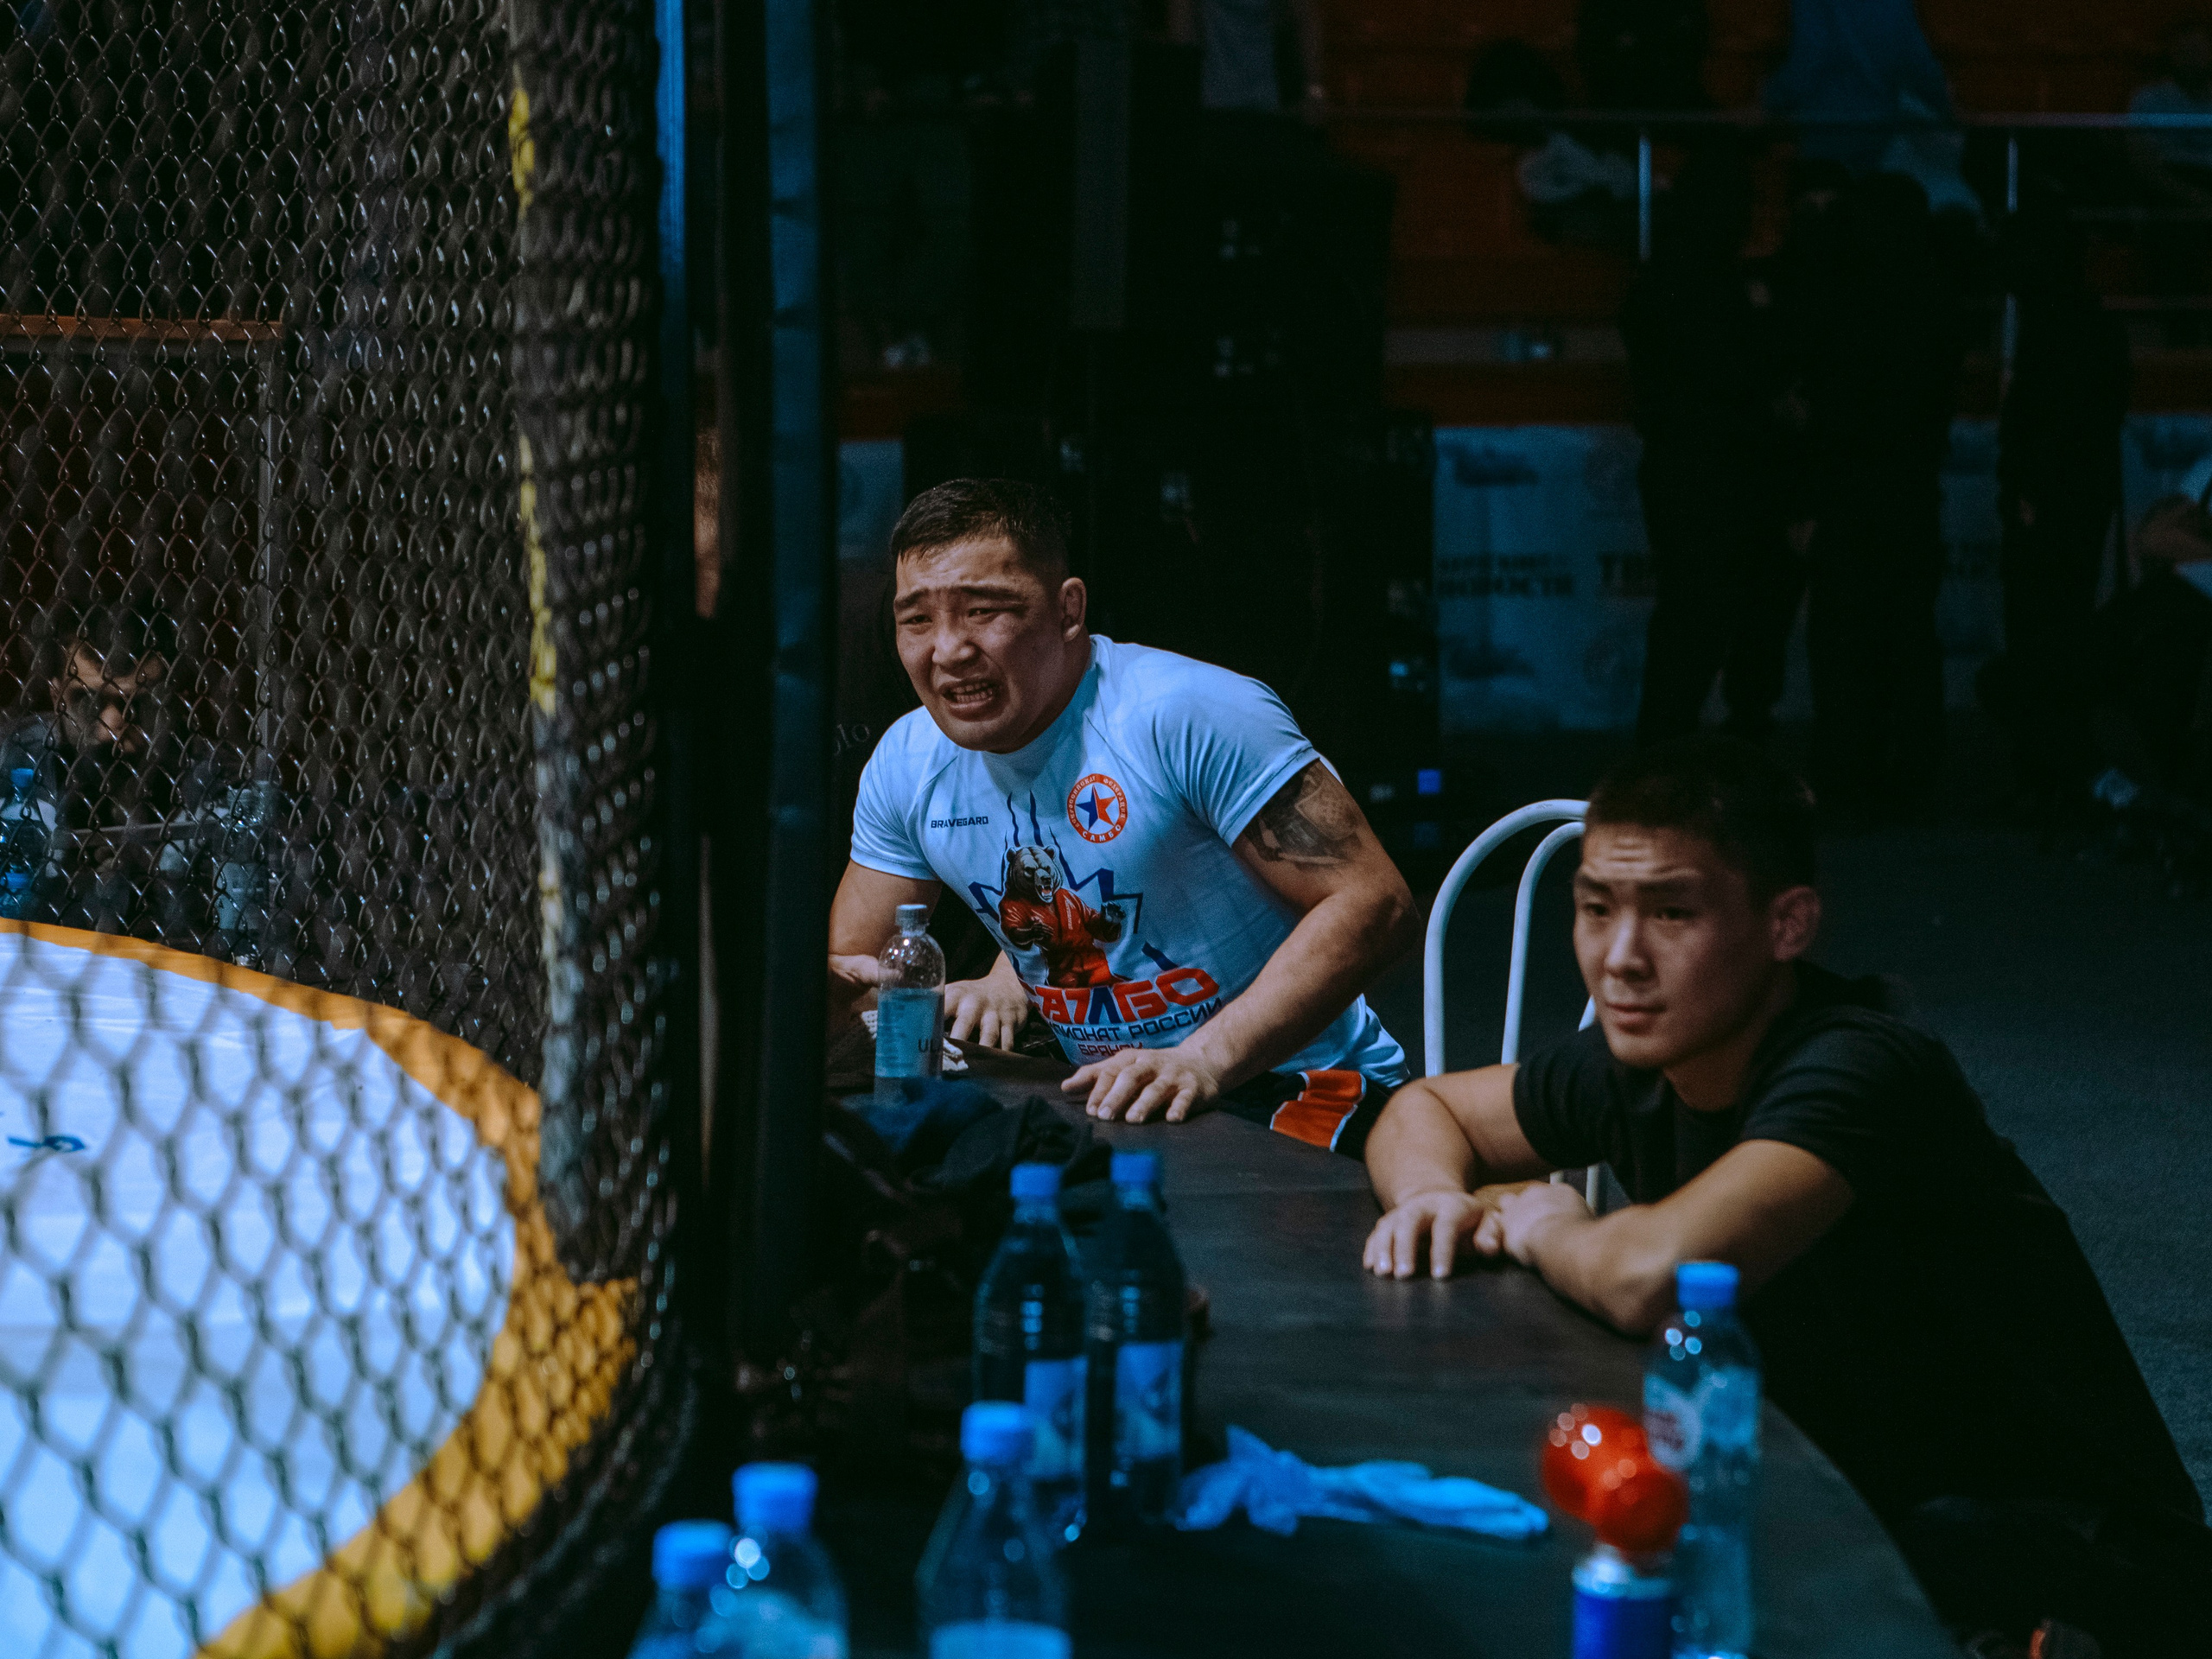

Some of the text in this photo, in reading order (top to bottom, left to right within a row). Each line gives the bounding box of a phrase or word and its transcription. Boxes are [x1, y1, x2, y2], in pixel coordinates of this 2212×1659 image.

[931, 816, 989, 829] BRAVEGARD
[1082, 823, 1122, 842] САМБО
[1128, 997, 1223, 1039] РОССИИ
